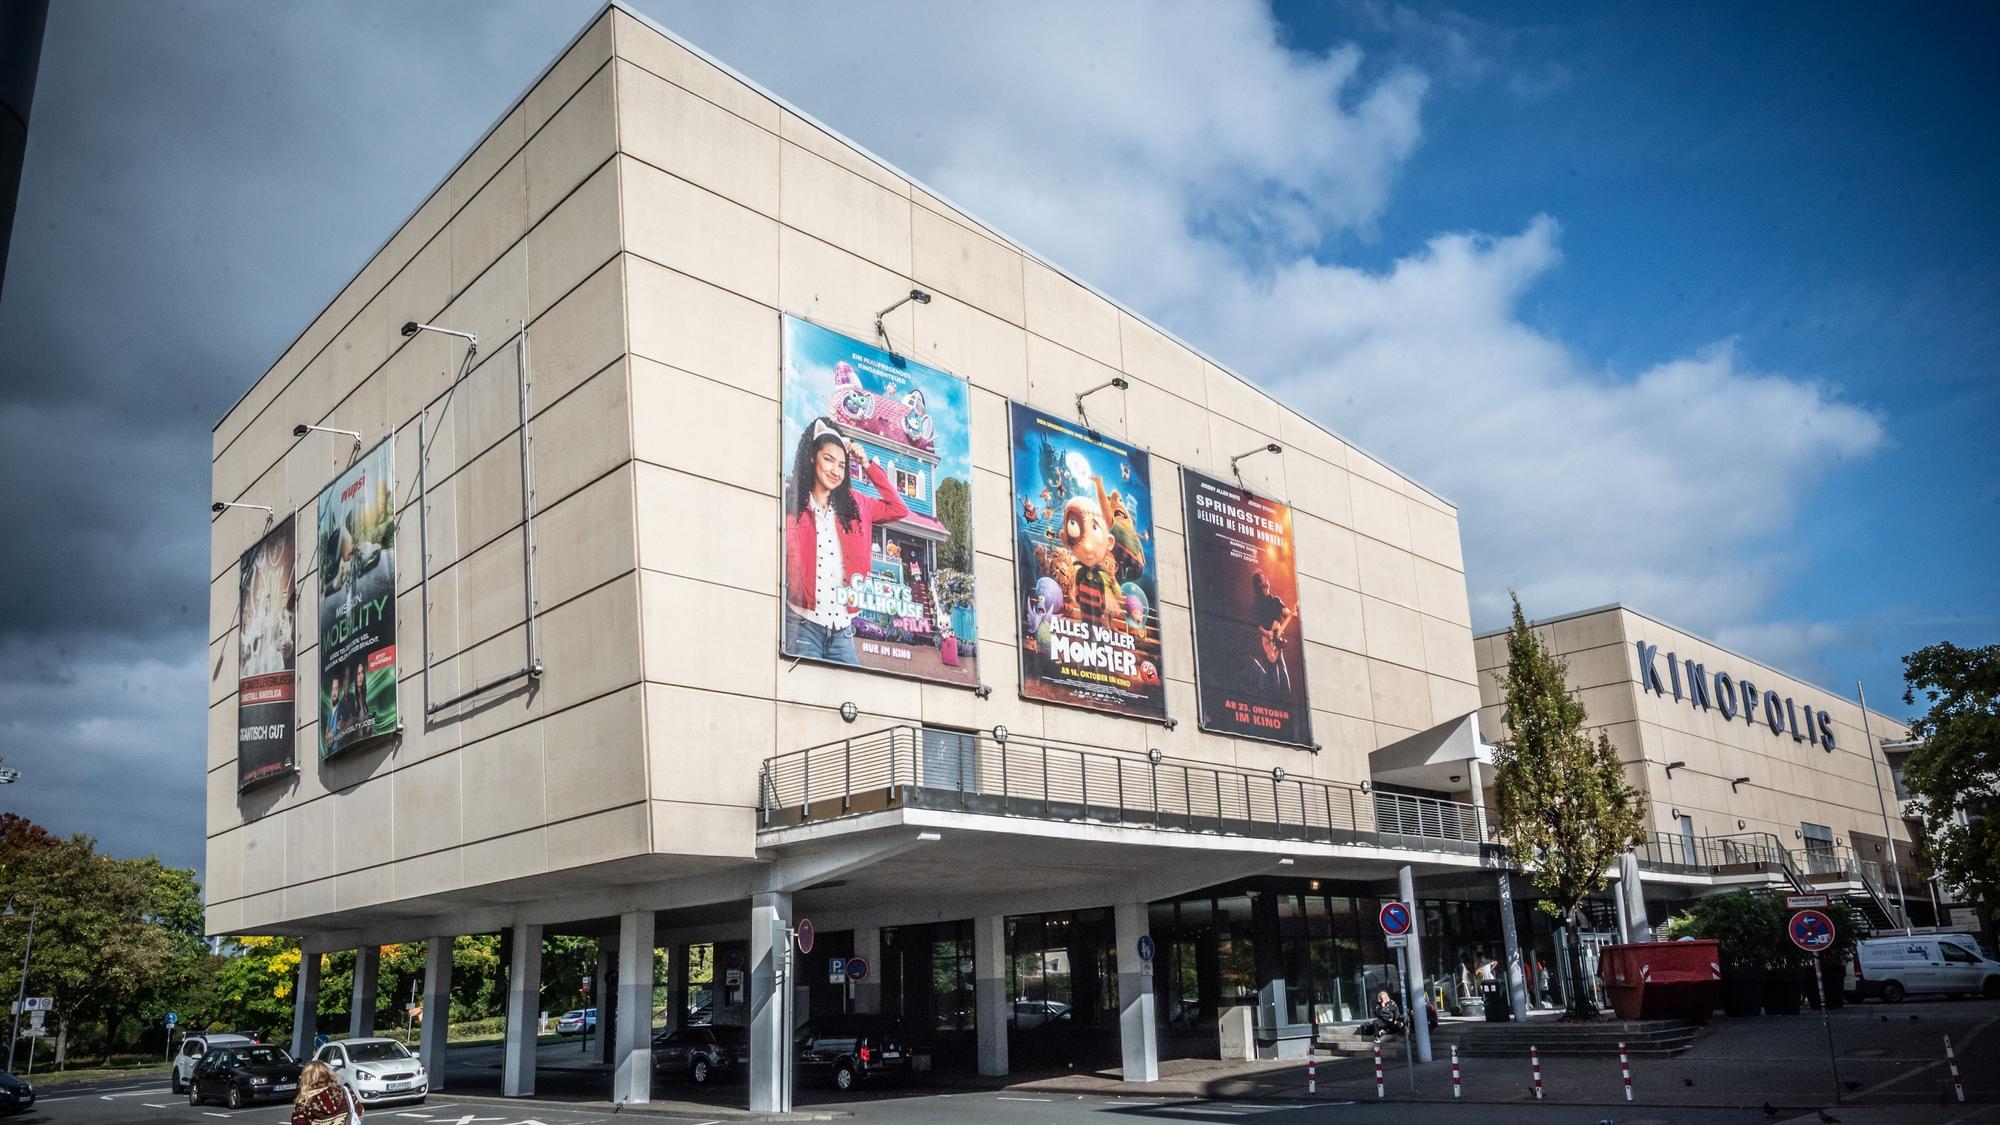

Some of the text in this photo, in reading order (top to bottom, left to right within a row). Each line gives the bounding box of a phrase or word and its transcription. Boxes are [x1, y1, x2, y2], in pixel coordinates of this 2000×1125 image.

[852, 353, 862, 361] EIN
[857, 362, 906, 384] KINOABENTEUER
[1200, 482, 1216, 492] JEREMY
[1216, 487, 1229, 497] ALLEN
[1195, 494, 1284, 534] SPRINGSTEEN
[1197, 509, 1224, 528] DELIVER
[1226, 518, 1236, 531] ME
[1238, 522, 1255, 537] FROM
[1257, 529, 1286, 548] NOWHERE
[851, 572, 913, 602] GABBY'S
[836, 585, 924, 619] DOLLHOUSE
[903, 617, 932, 633] FILM
[1049, 615, 1136, 651] ALLES VOLLER
[862, 642, 911, 660] NUR IM KINO
[1050, 634, 1138, 676] MONSTER
[1061, 667, 1070, 675] AB
[1080, 670, 1109, 683] OKTOBER
[1109, 676, 1117, 684] IM
[1117, 678, 1131, 688] KINO
[1637, 640, 1836, 752] KINOPOLIS
[1225, 700, 1289, 720] AB 23. OKTOBER
[1235, 711, 1281, 729] IM KINO
[269, 724, 285, 739] GUT
[833, 960, 842, 973] P
